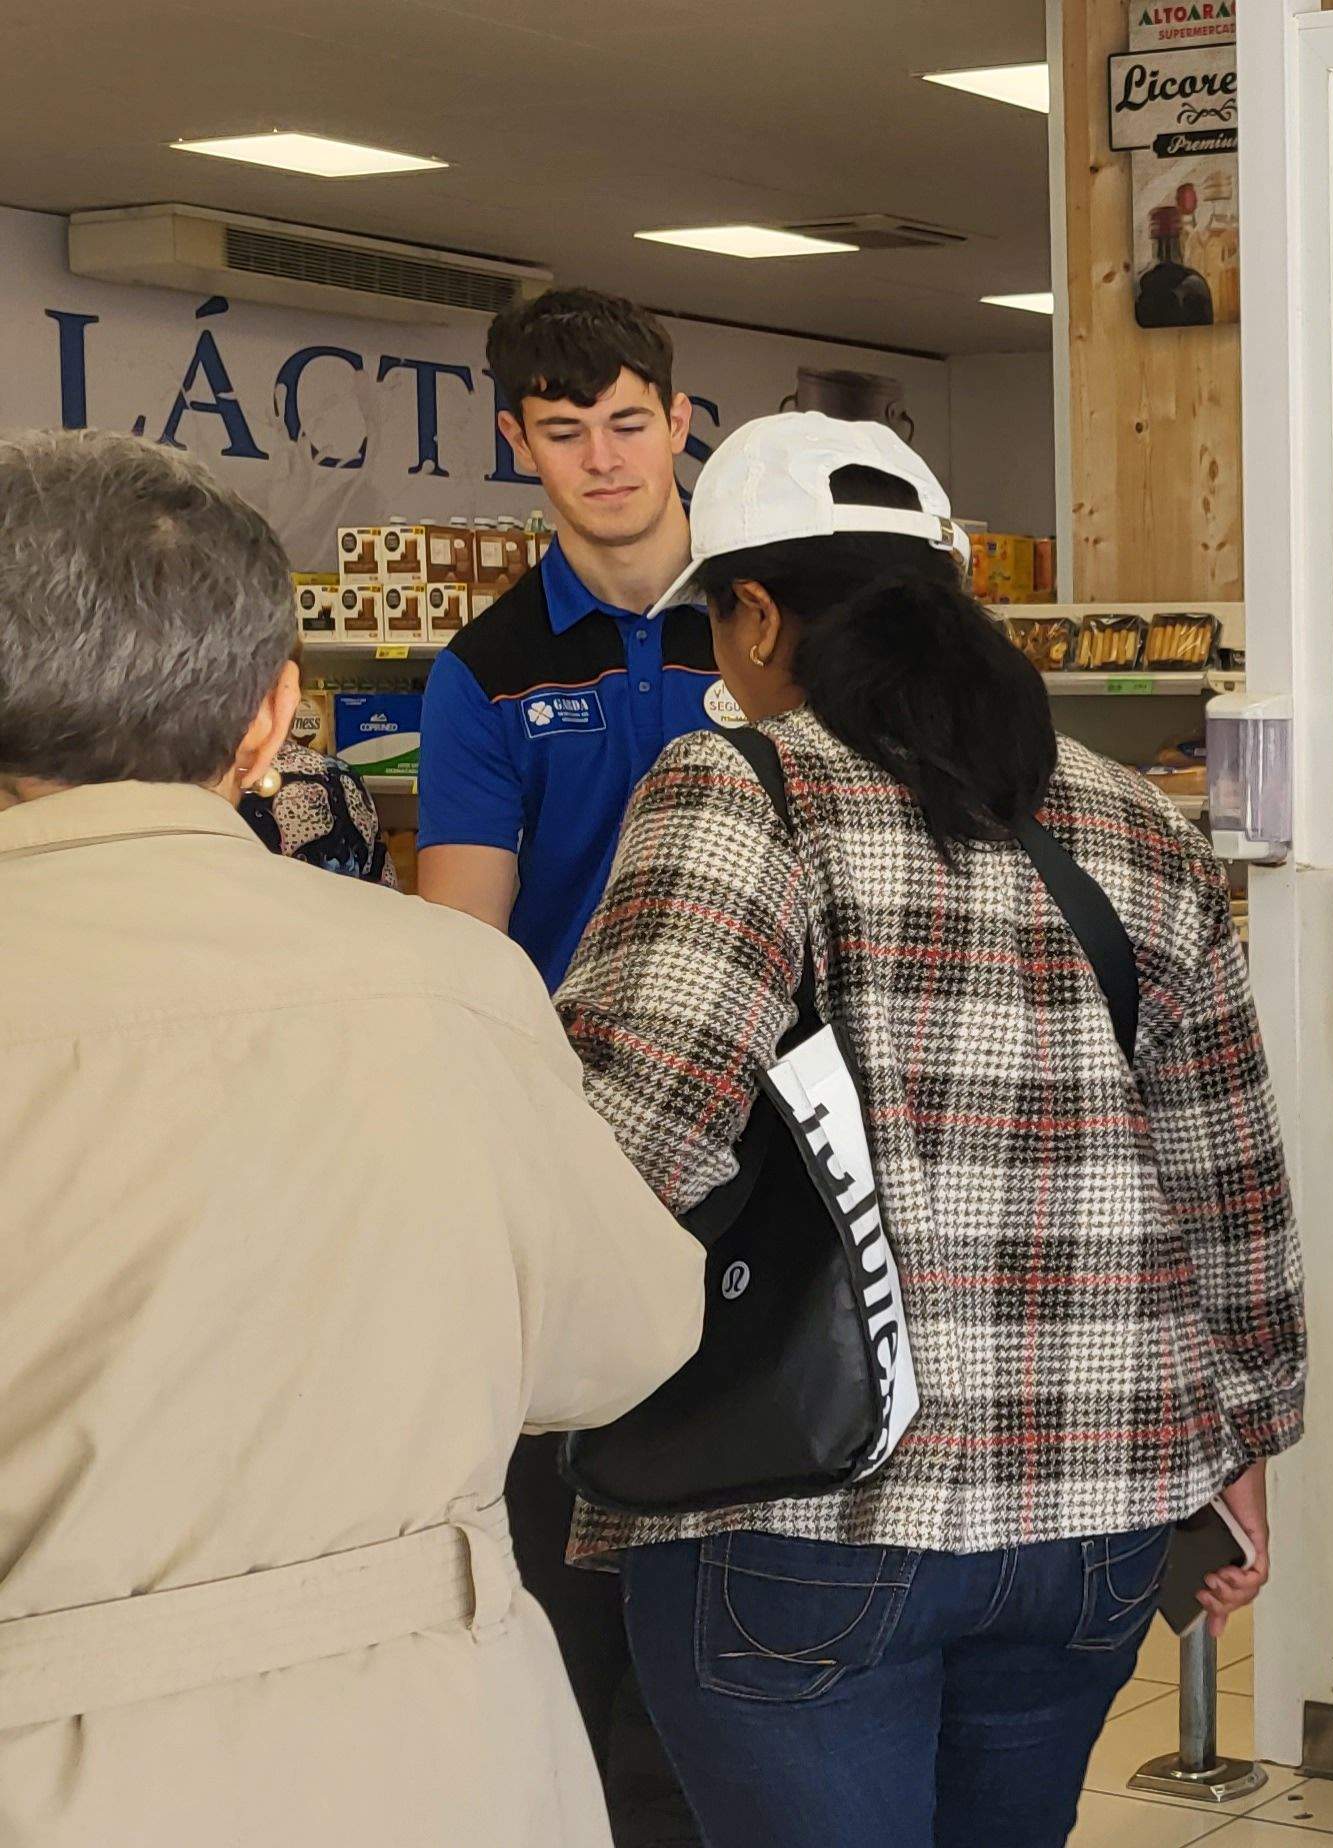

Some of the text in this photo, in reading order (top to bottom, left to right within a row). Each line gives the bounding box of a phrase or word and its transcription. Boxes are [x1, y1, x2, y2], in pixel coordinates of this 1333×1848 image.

[1139, 1, 1236, 25] ALTOARA
[1158, 23, 1237, 40] SUPERMERCAD
[1115, 64, 1237, 113] Licore
[709, 700, 740, 712] SEGU
